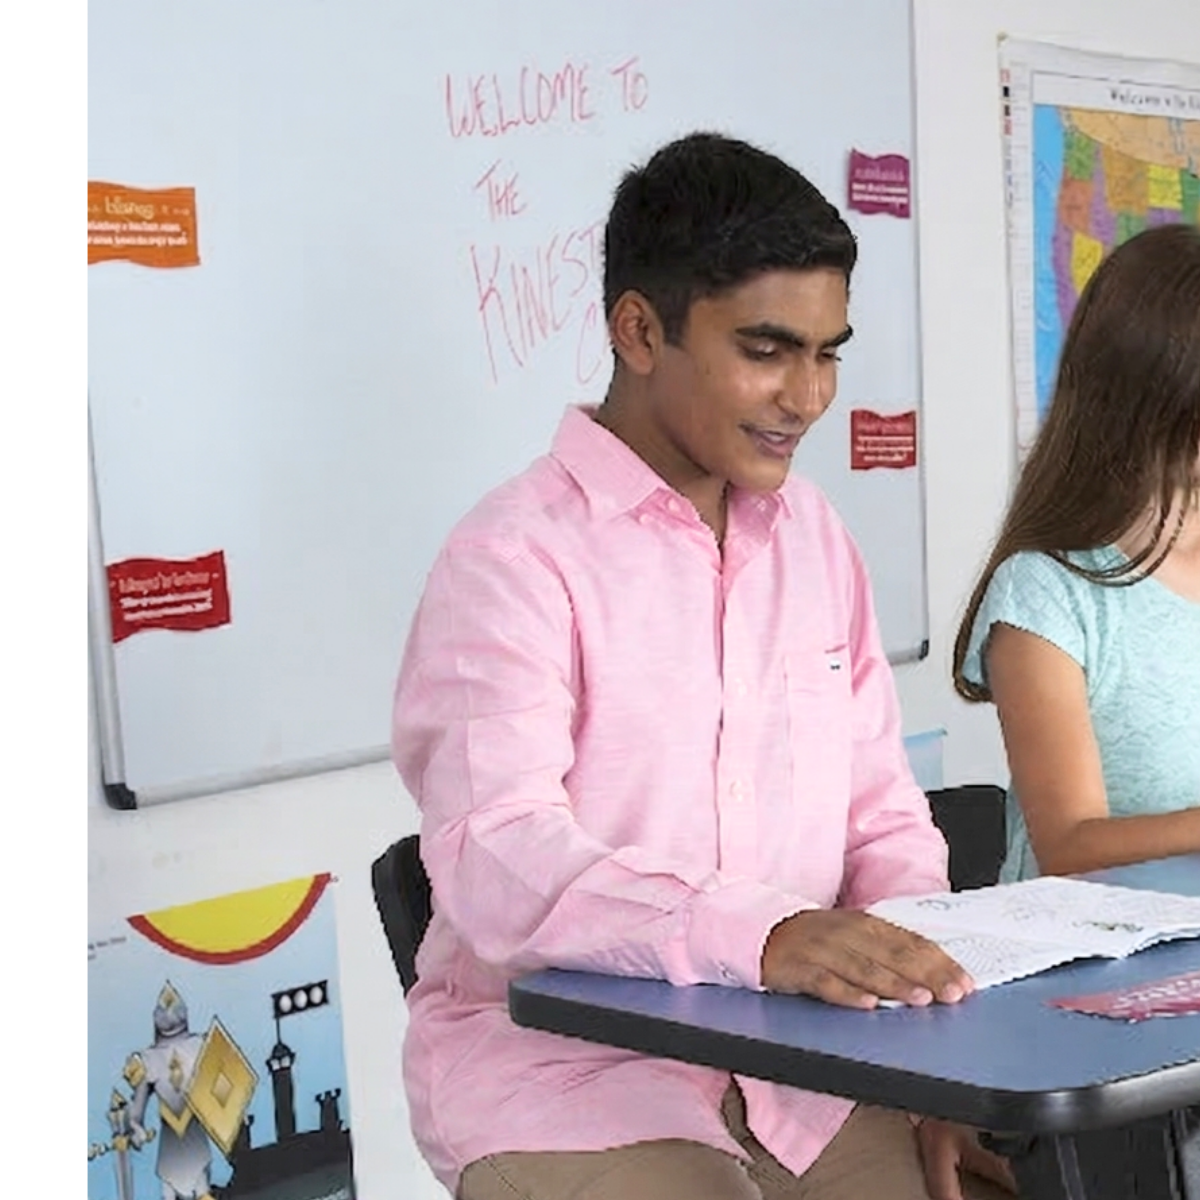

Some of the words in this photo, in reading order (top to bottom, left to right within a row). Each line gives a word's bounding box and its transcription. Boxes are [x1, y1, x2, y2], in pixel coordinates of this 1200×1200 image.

[446, 62, 597, 137] WELCOME
[612, 56, 649, 112] TO
[475, 159, 527, 221] THE
